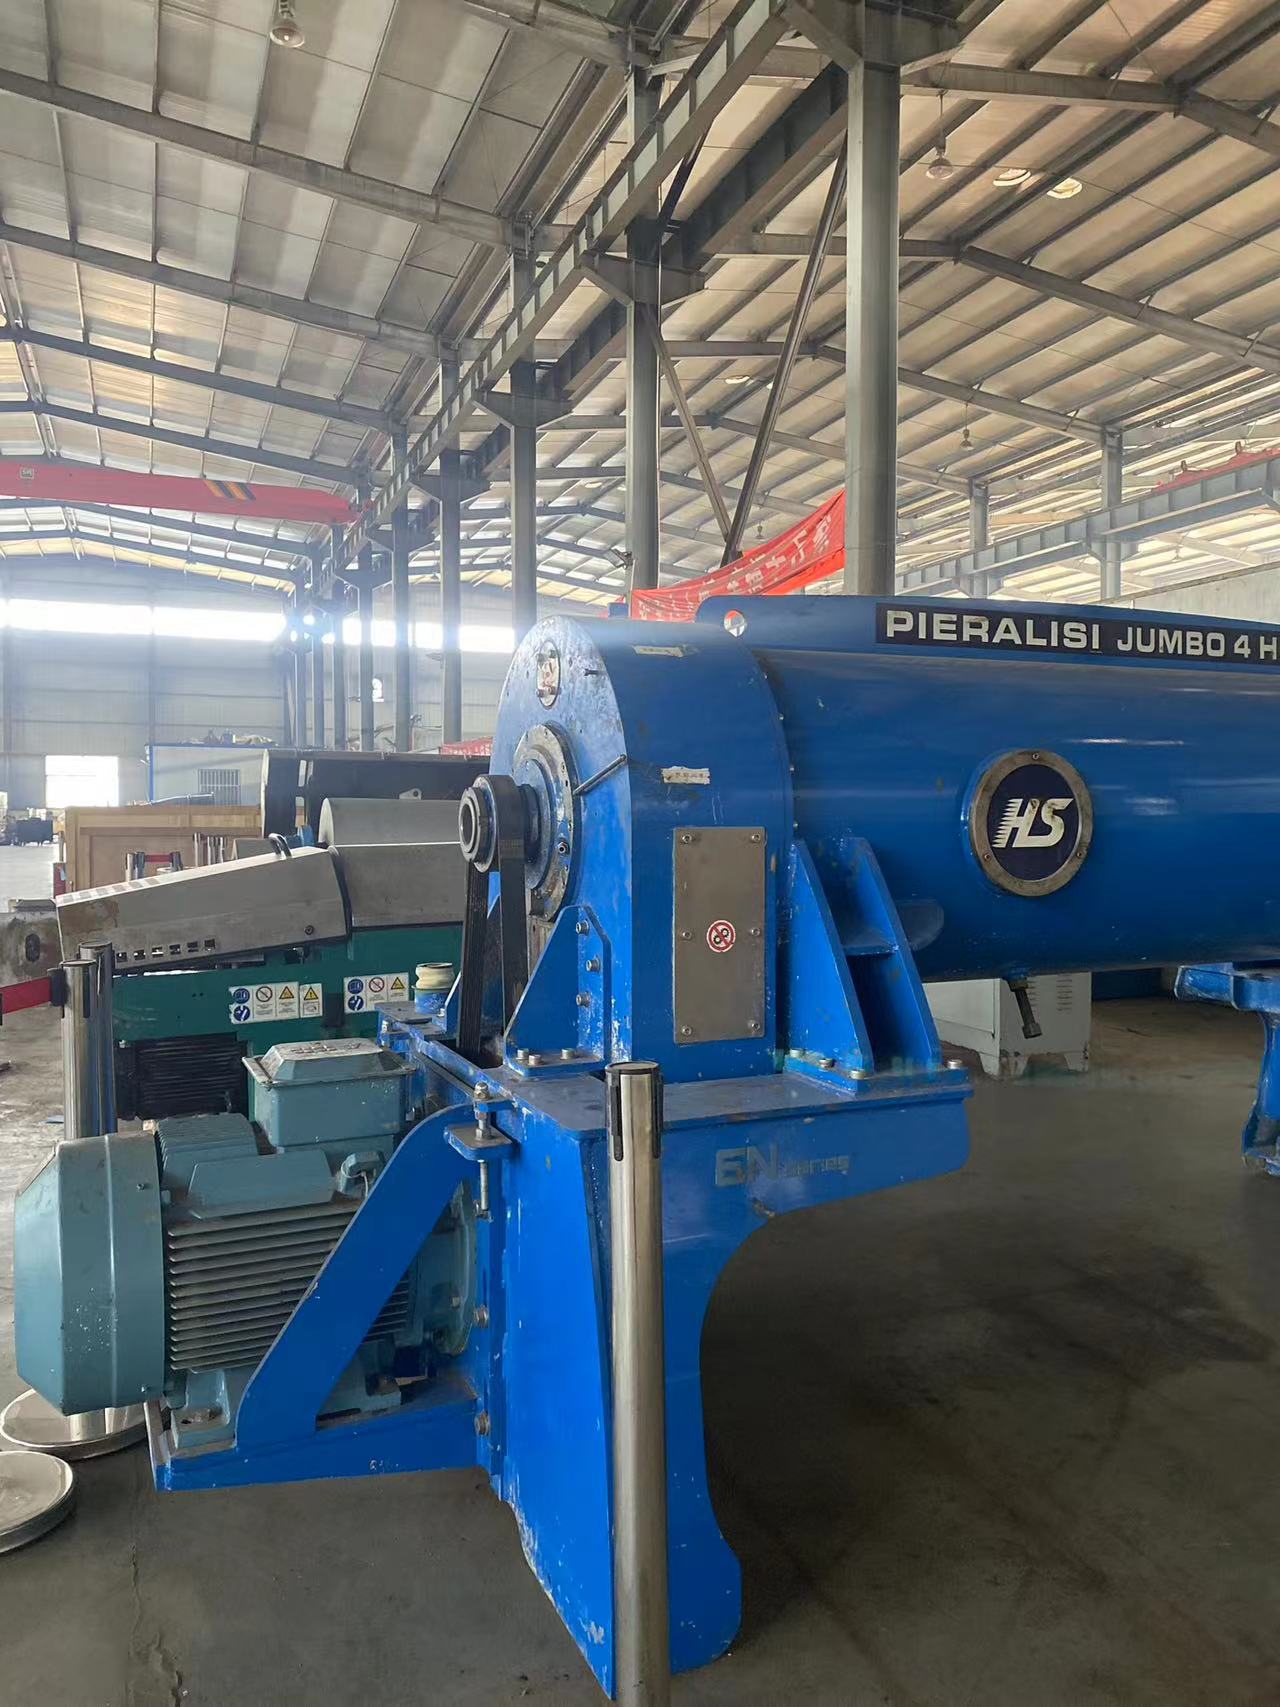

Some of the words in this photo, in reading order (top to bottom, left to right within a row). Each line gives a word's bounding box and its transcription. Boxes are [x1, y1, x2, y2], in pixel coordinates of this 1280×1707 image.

[886, 609, 1100, 650] PIERALISI
[1117, 626, 1225, 657] JUMBO
[1233, 634, 1252, 658] 4
[991, 798, 1074, 848] HS
